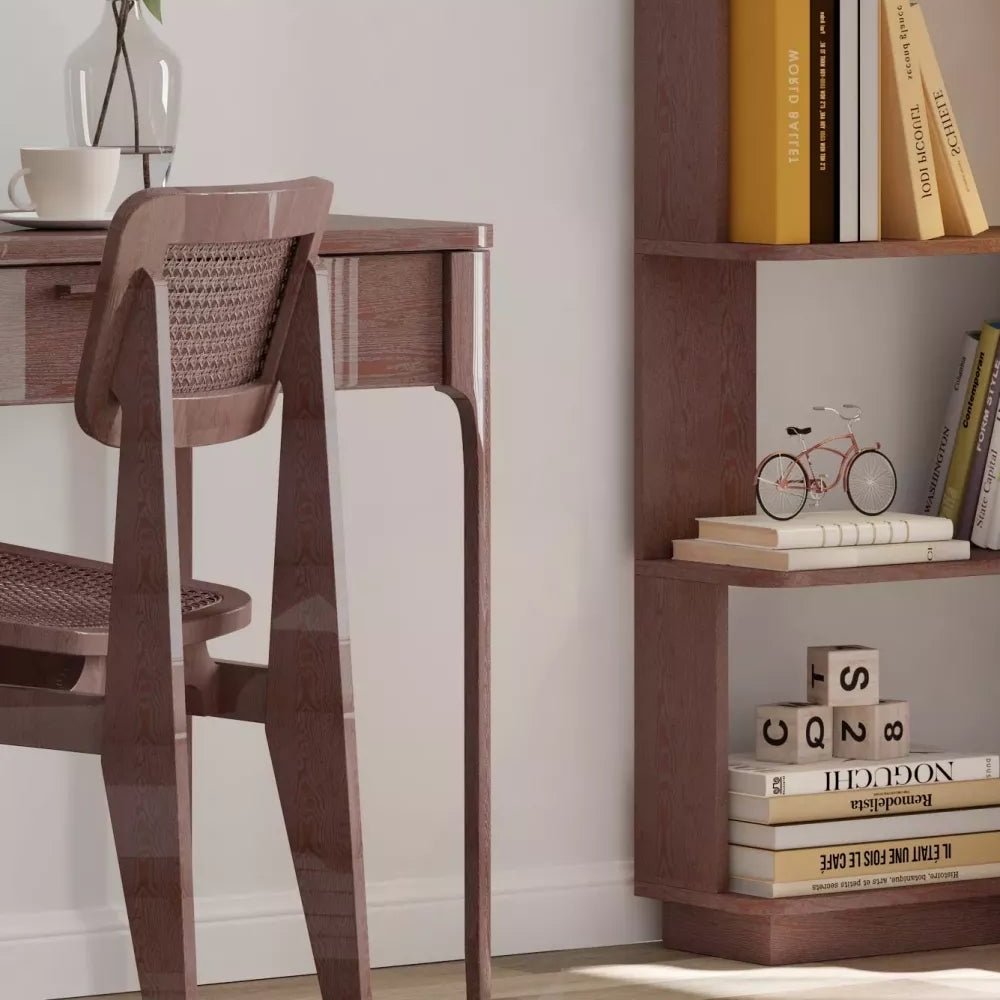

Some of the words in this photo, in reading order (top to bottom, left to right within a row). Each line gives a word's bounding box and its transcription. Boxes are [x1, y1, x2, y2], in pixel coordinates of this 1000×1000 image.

[976, 407, 992, 452] FORM
[986, 358, 1000, 407] STYLE
[924, 426, 951, 513] WASHINGTON
[982, 449, 998, 494] Capital
[976, 495, 989, 529] State
[811, 663, 825, 688] T
[839, 665, 870, 691] S
[763, 718, 788, 747] C
[806, 716, 825, 749] Q
[841, 720, 867, 742] 2
[884, 720, 904, 741] 8
[824, 761, 954, 791] NOGUCHI
[850, 793, 933, 811] Remodelista
[849, 851, 861, 867] LE
[863, 849, 886, 866] FOIS
[889, 847, 909, 864] UNE
[911, 844, 940, 863] ÉTAIT
[942, 843, 952, 859] IL
[820, 853, 846, 874] CAFÉ
[840, 879, 861, 888] petits
[863, 878, 871, 886] et
[872, 876, 888, 884] arts
[889, 874, 926, 885] botanique,
[928, 870, 959, 880] Histoire,
[812, 882, 839, 891] secrets
